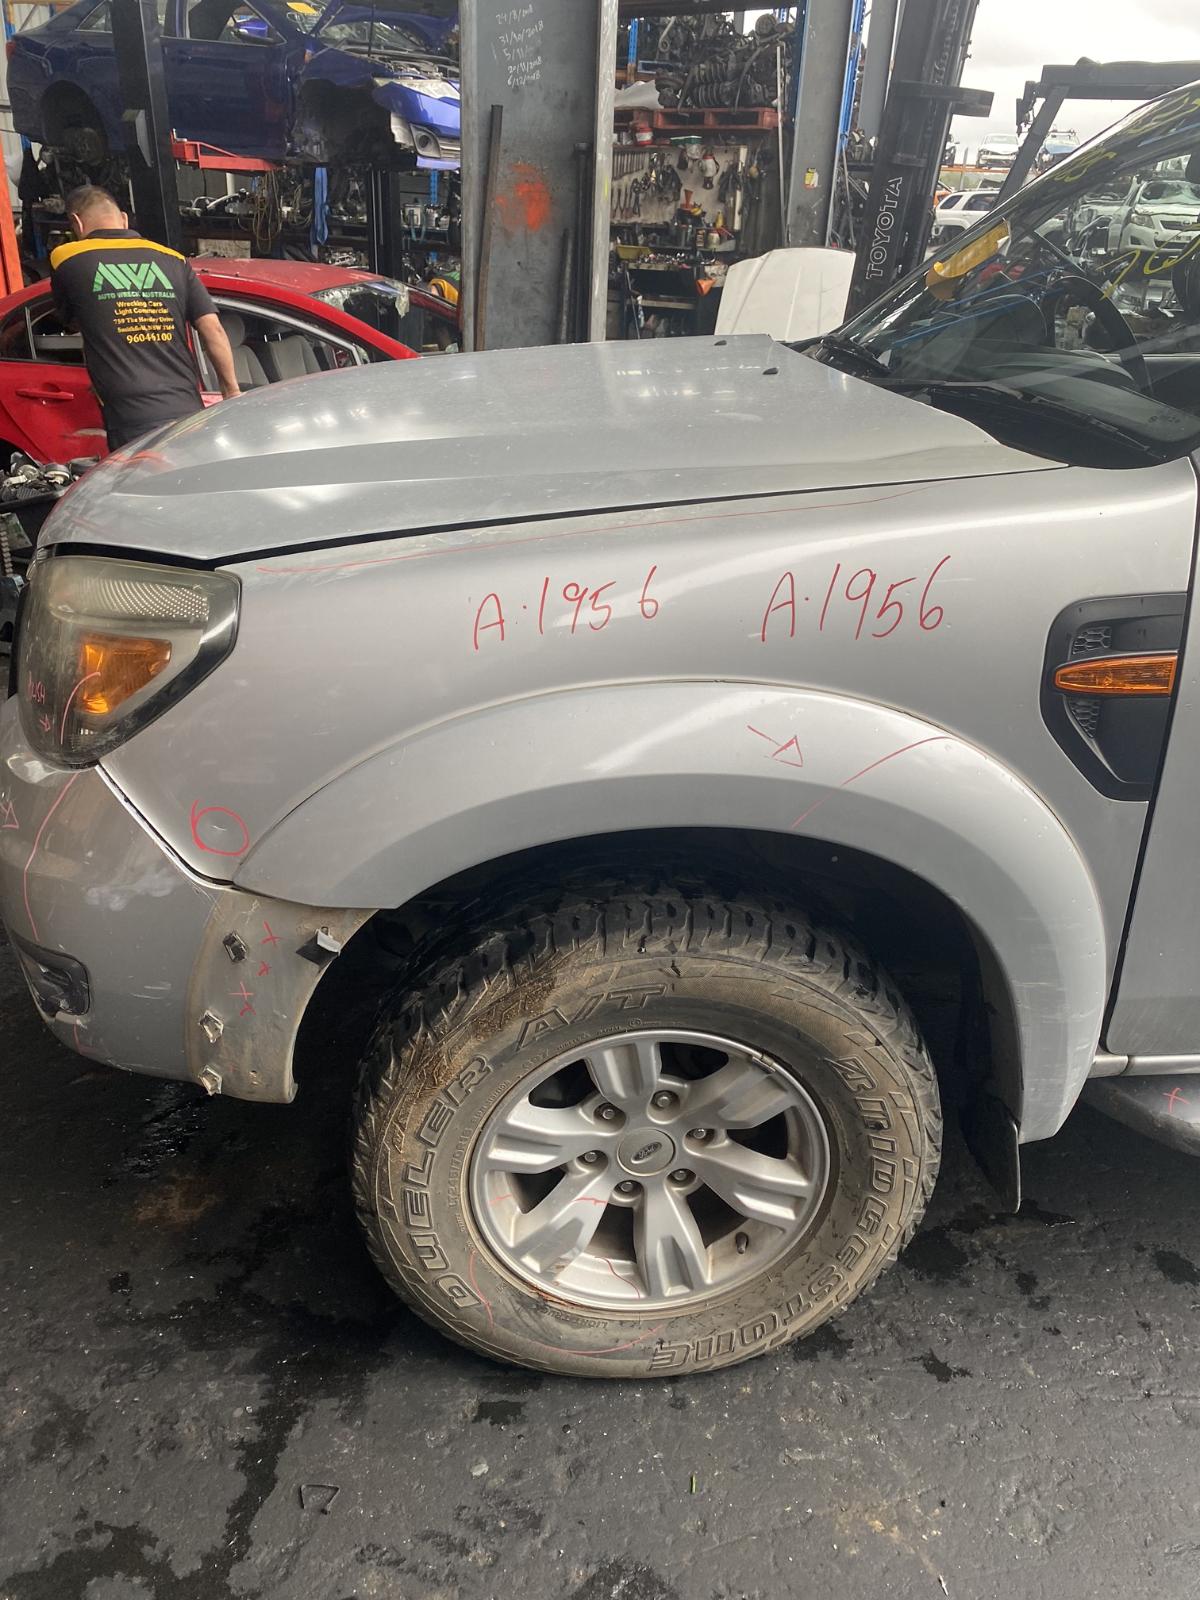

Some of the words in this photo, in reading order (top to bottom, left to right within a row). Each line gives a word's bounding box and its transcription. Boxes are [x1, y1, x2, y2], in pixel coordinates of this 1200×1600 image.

[865, 176, 903, 280] TOYOTA
[97, 292, 117, 301] AUTO
[142, 291, 176, 299] AUSTRALIA
[114, 308, 133, 316] Light
[133, 307, 169, 315] Commercial
[116, 300, 148, 308] Wrecking
[148, 300, 164, 308] Cars
[516, 983, 669, 1052] A/T
[401, 1053, 494, 1309] DUELER
[648, 1055, 899, 1372] BRIDGESTONE
